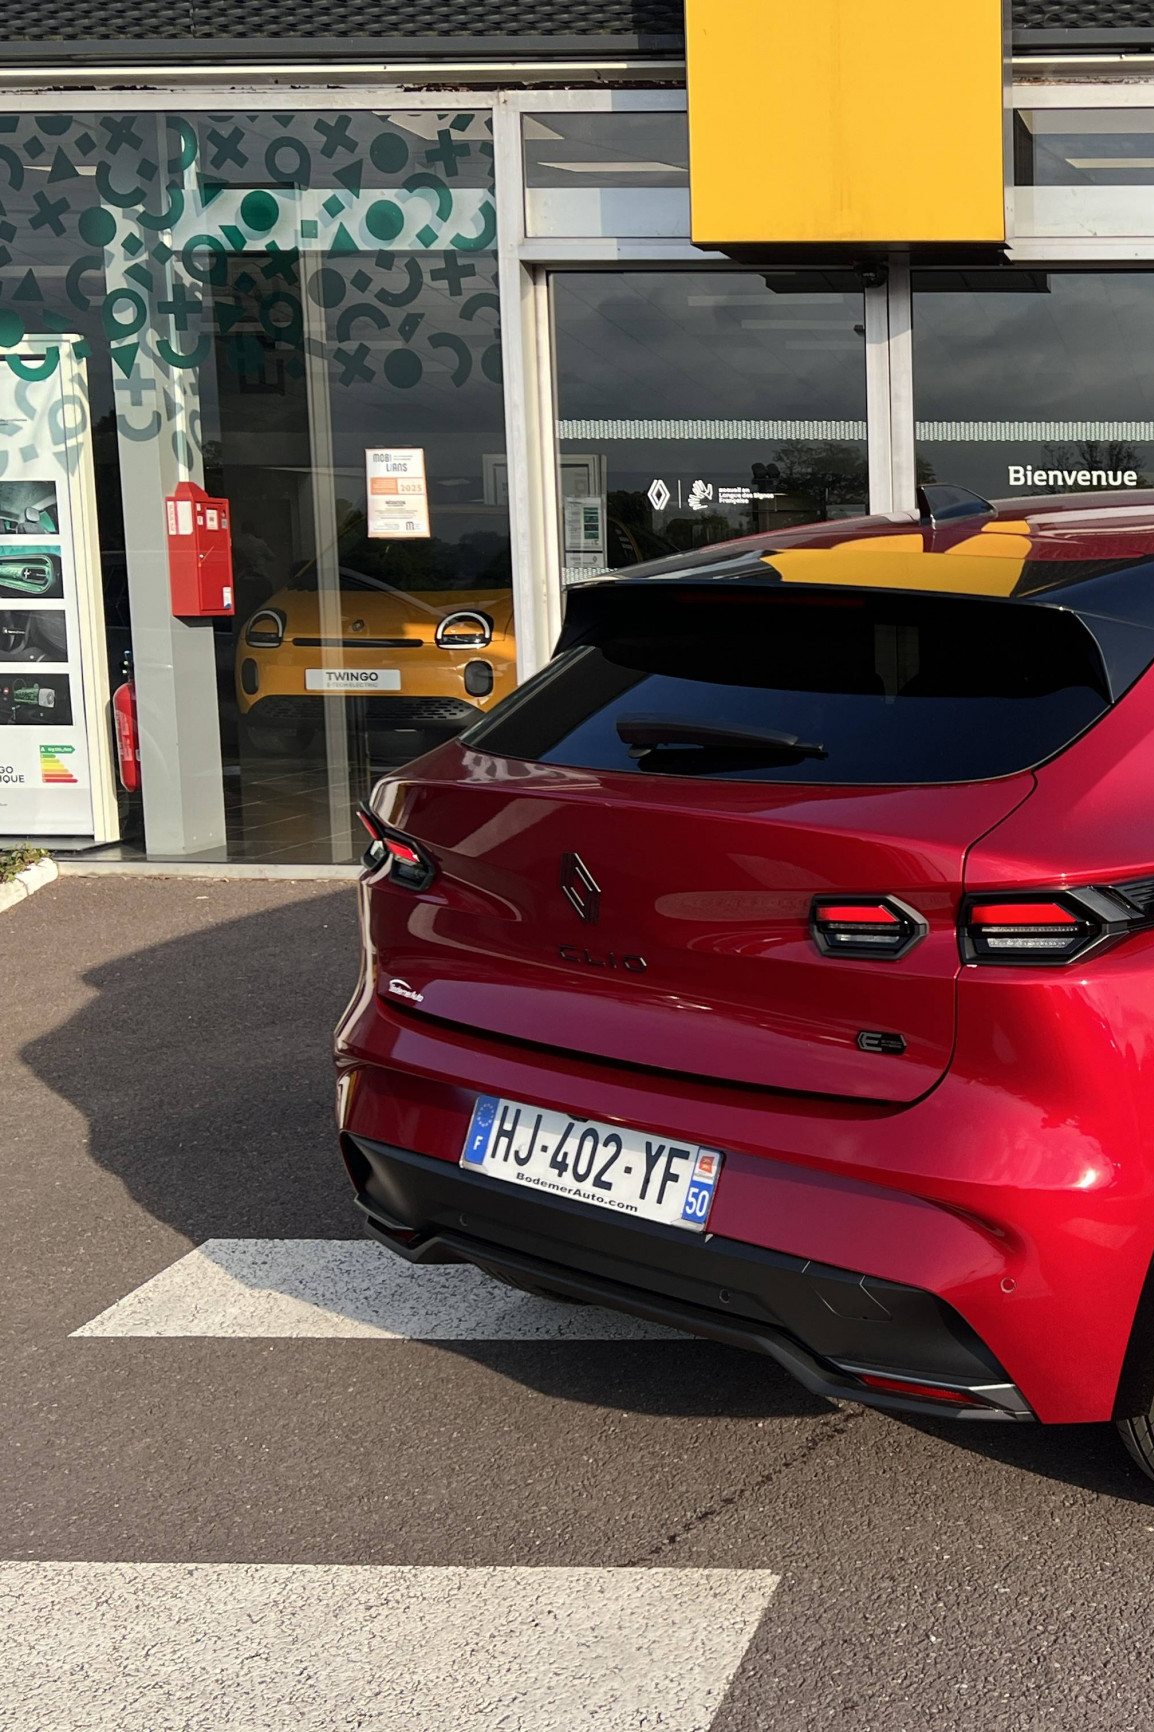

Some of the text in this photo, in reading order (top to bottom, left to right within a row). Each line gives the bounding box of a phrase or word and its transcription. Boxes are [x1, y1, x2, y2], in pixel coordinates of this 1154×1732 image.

[1008, 465, 1138, 486] Bienvenue
[326, 672, 378, 681] TWINGO
[559, 944, 648, 972] CLIO
[473, 1136, 484, 1150] F
[490, 1105, 690, 1205] HJ-402-YF
[516, 1172, 639, 1213] BodemerAuto.com
[684, 1187, 710, 1217] 50
